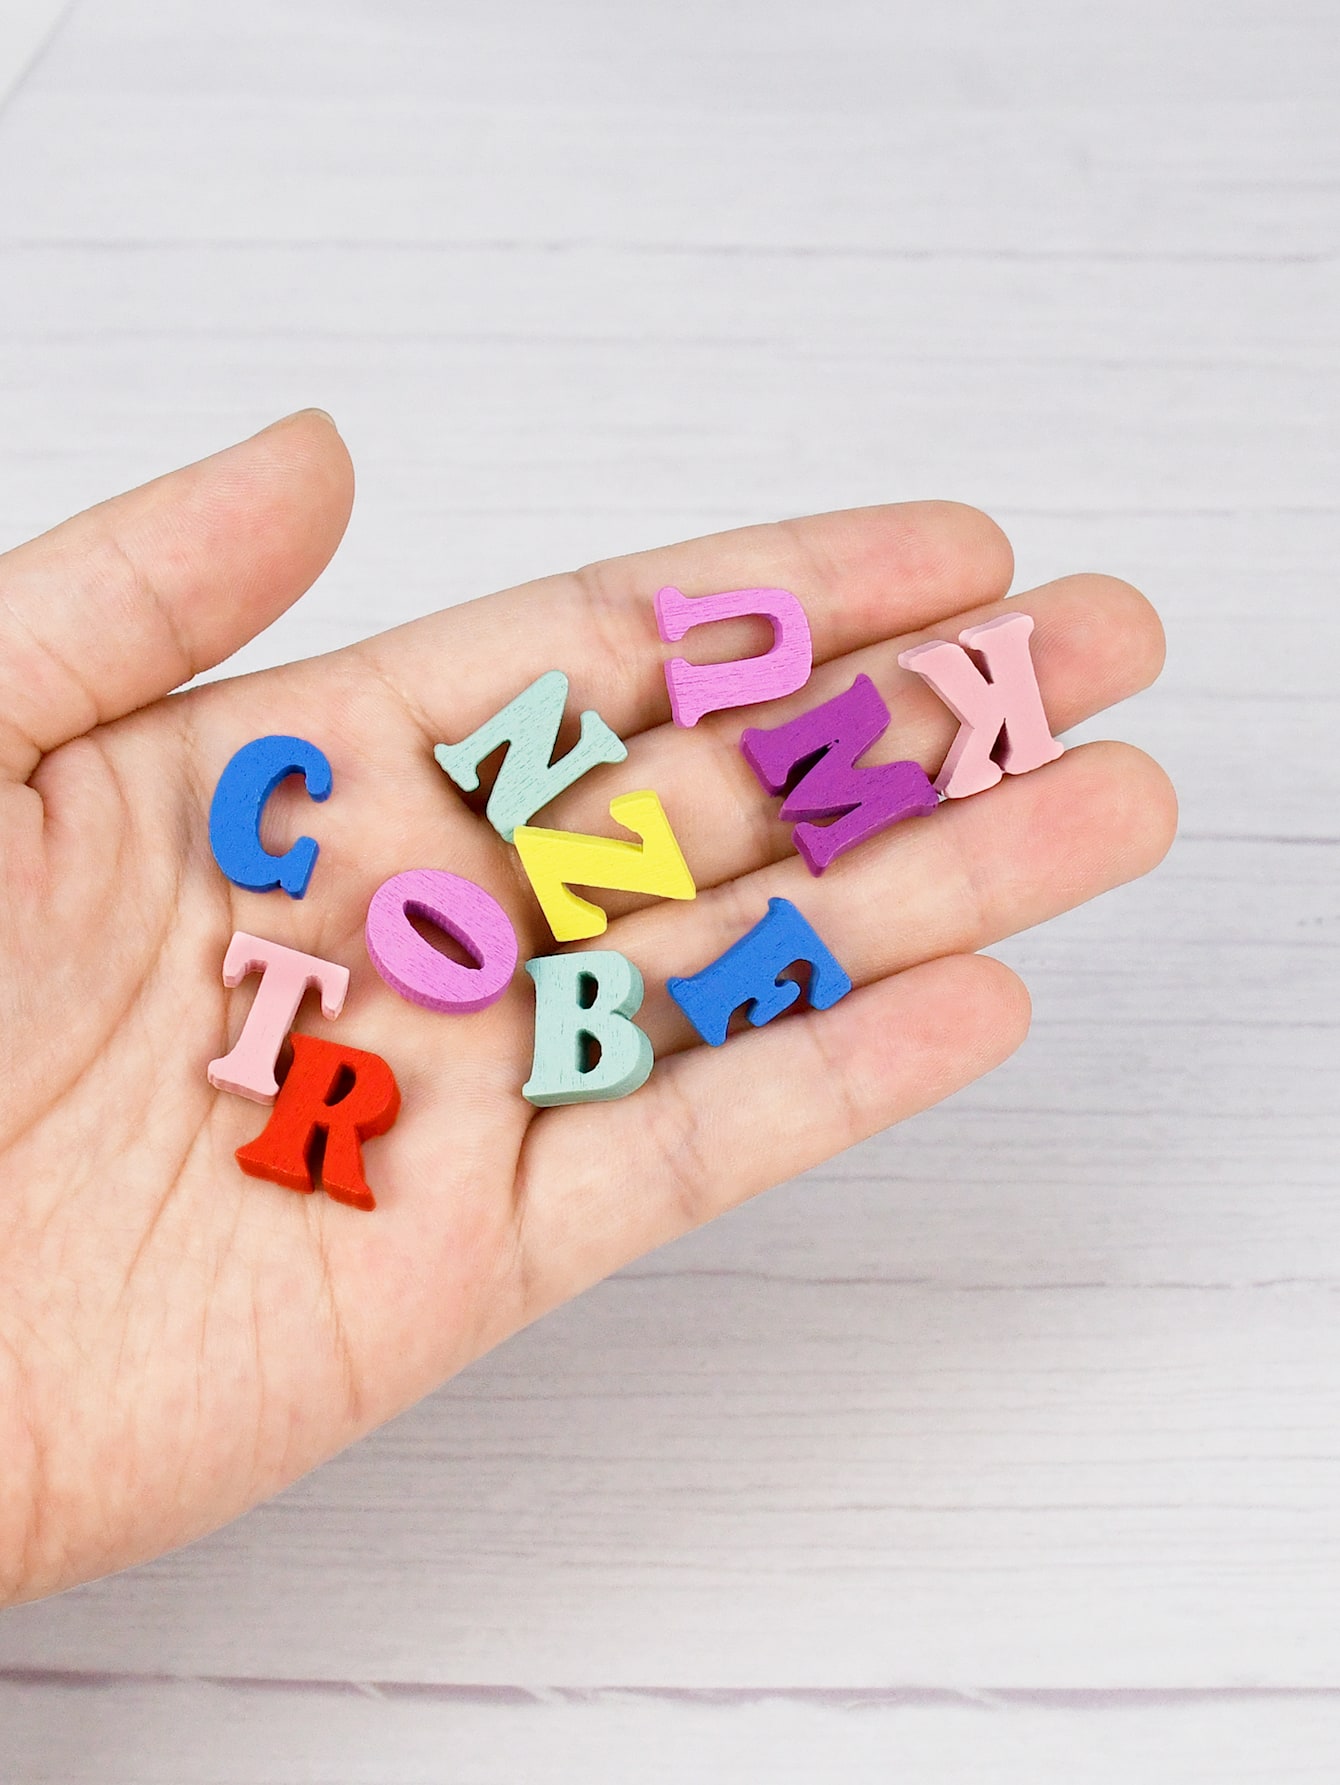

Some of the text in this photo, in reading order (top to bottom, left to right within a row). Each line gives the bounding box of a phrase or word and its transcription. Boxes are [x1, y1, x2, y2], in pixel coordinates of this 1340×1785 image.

[654, 587, 813, 728] U
[898, 612, 1064, 799] K
[208, 735, 333, 900] C
[207, 931, 351, 1106] T
[365, 868, 519, 1015] O
[522, 951, 654, 1108] B
[235, 1033, 401, 1212] R
